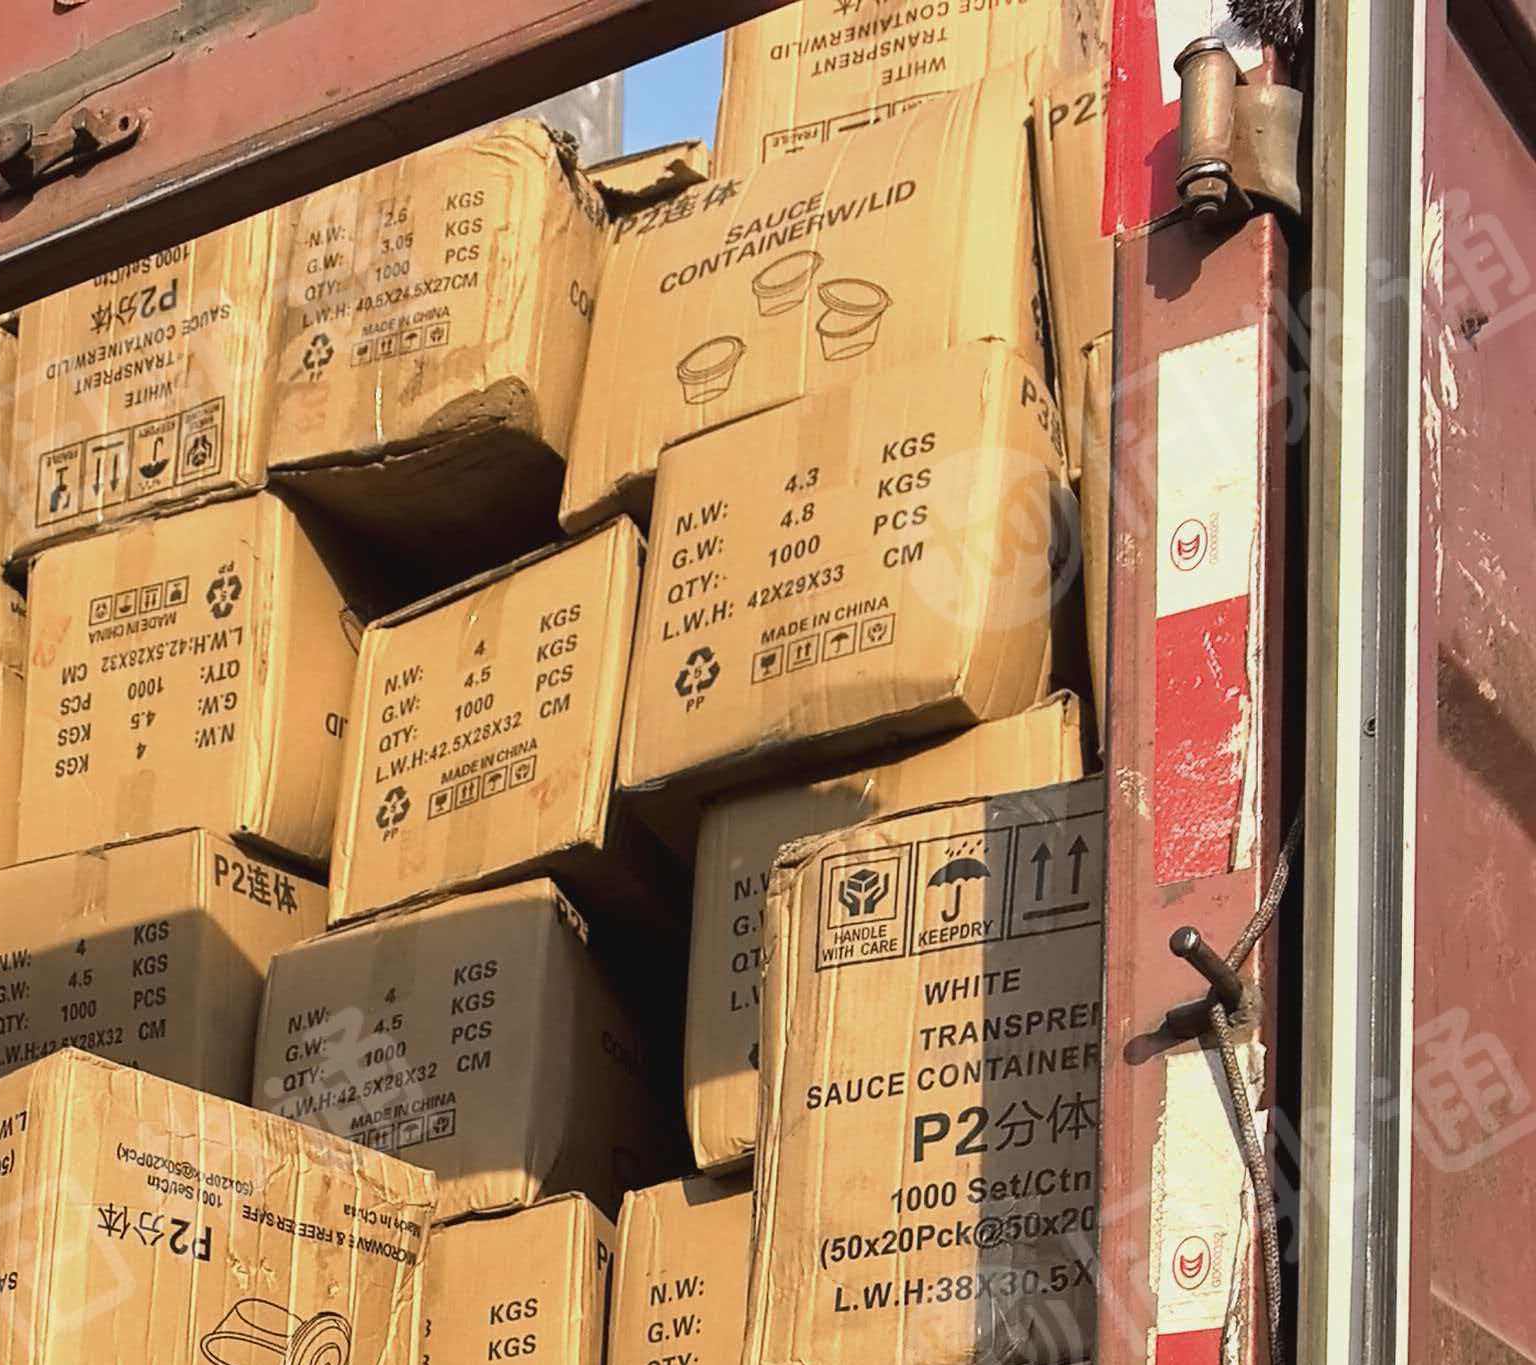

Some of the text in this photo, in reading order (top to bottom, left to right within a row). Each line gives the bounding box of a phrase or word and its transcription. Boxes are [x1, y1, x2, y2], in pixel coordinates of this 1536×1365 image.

[811, 28, 948, 77] TRANSPRENT
[881, 56, 947, 86] WHITE
[308, 228, 346, 248] N.W:
[444, 191, 485, 210] KGS
[658, 179, 918, 295] CONTAINERW/LID
[724, 192, 826, 246] SAUCE
[90, 278, 178, 333] P2分体
[302, 304, 352, 328] L.W.H:
[45, 303, 232, 380] SAUCE CONTAINERW/LID
[74, 352, 175, 394] TRANSPRENT
[124, 381, 173, 409] WHITE
[675, 432, 936, 536] N.W: 4.3 KGS
[671, 469, 932, 571] G.W: 4.8 KGS
[666, 505, 929, 606] QTY: 1000 PCS
[660, 541, 925, 642] L.W.H: 42X29X33 CM
[383, 604, 581, 695] N.W: 4 KGS
[381, 635, 578, 723] G.W: 4.5 KGS
[378, 665, 574, 753] QTY: 1000 PCS
[375, 695, 571, 784] L.W.H:42.5X28X32 CM
[213, 853, 298, 916] P2连体
[821, 938, 898, 963] WITH CARE
[833, 924, 887, 945] HANDLE
[918, 920, 994, 948] KEEPDRY
[924, 969, 1021, 1006] WHITE
[912, 1092, 1098, 1162] P2分体
[891, 1169, 1092, 1214] 1000 Set/Ctn
